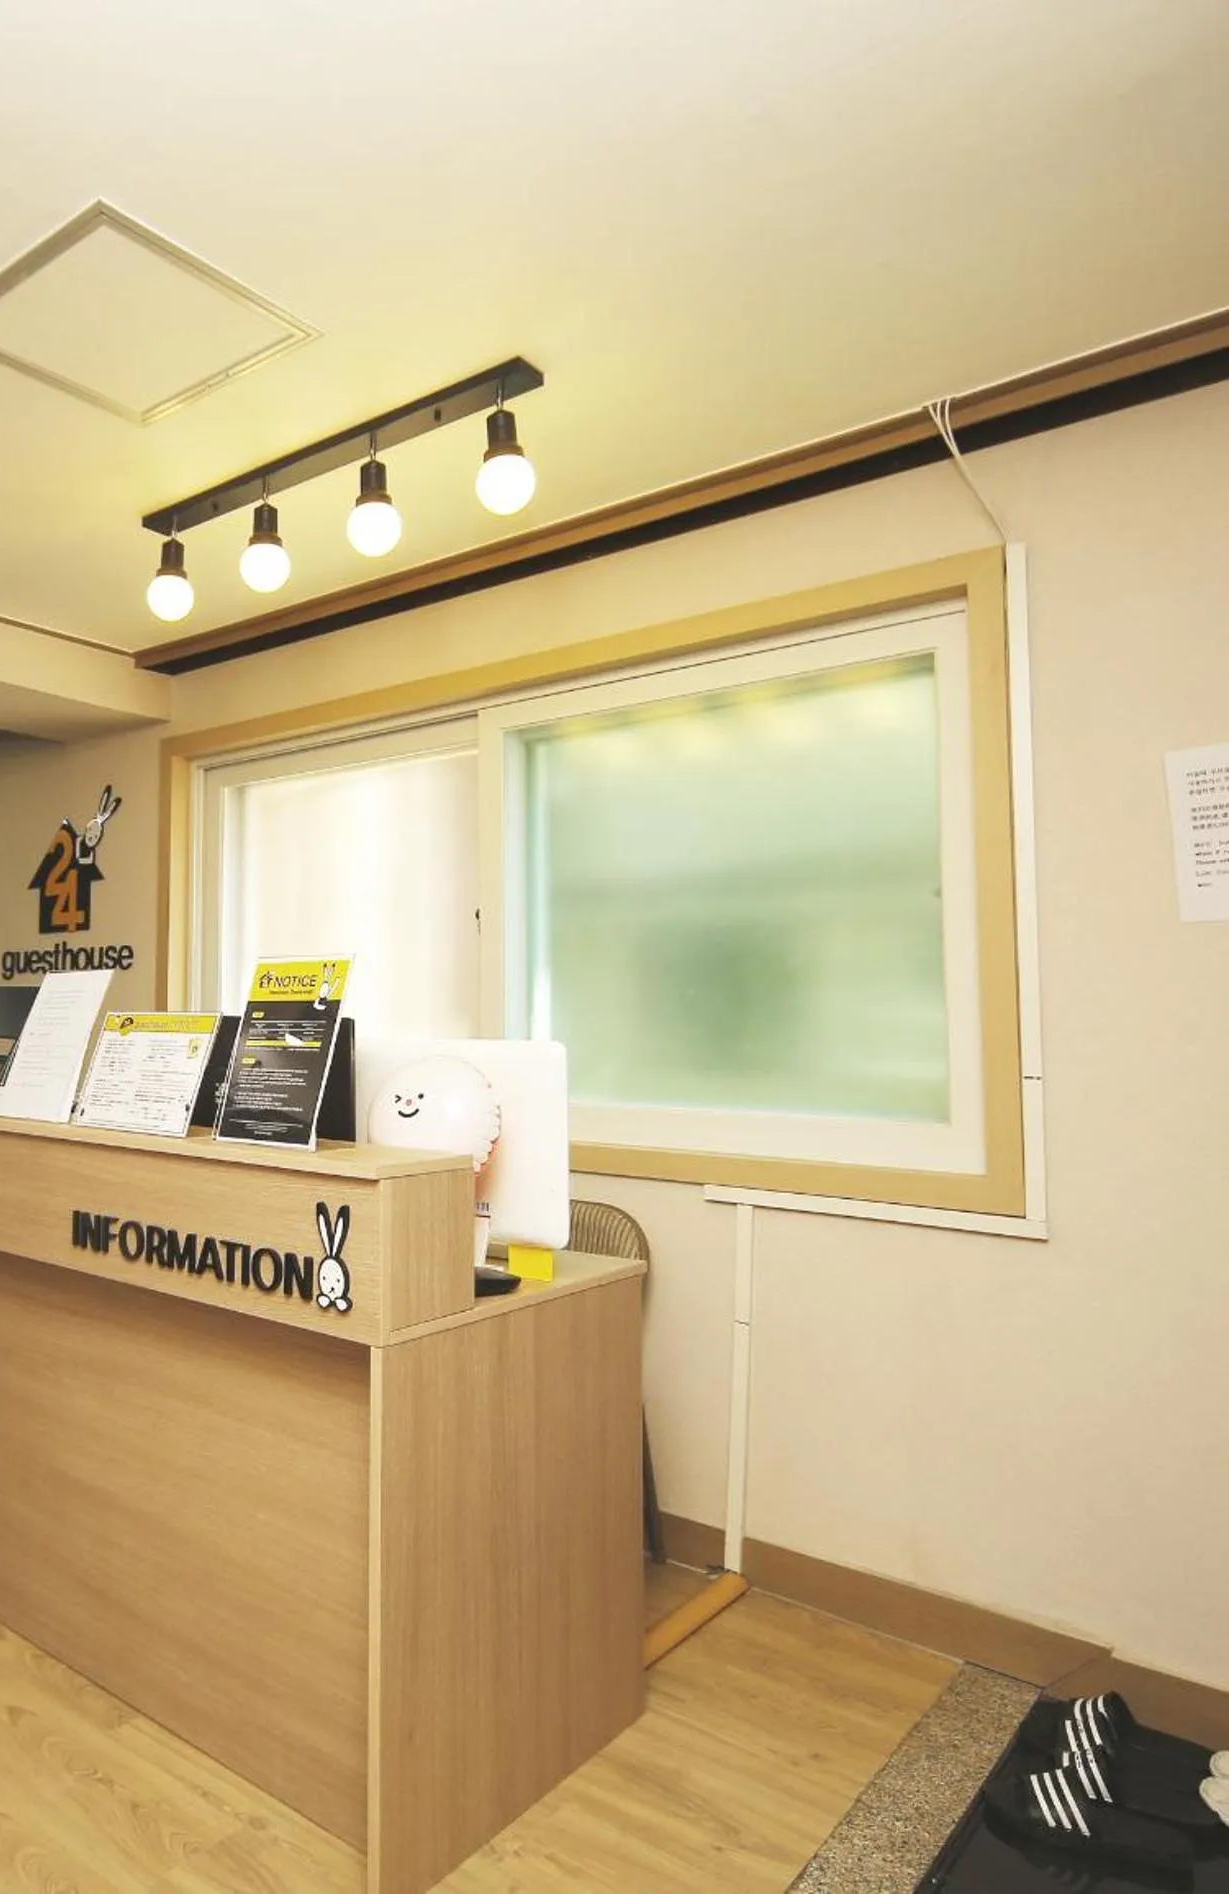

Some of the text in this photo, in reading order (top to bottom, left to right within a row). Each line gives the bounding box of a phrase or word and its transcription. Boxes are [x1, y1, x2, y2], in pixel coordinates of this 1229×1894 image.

[1, 940, 134, 981] guesthouse
[274, 974, 319, 988] NOTICE
[72, 1210, 314, 1303] INFORMATION
